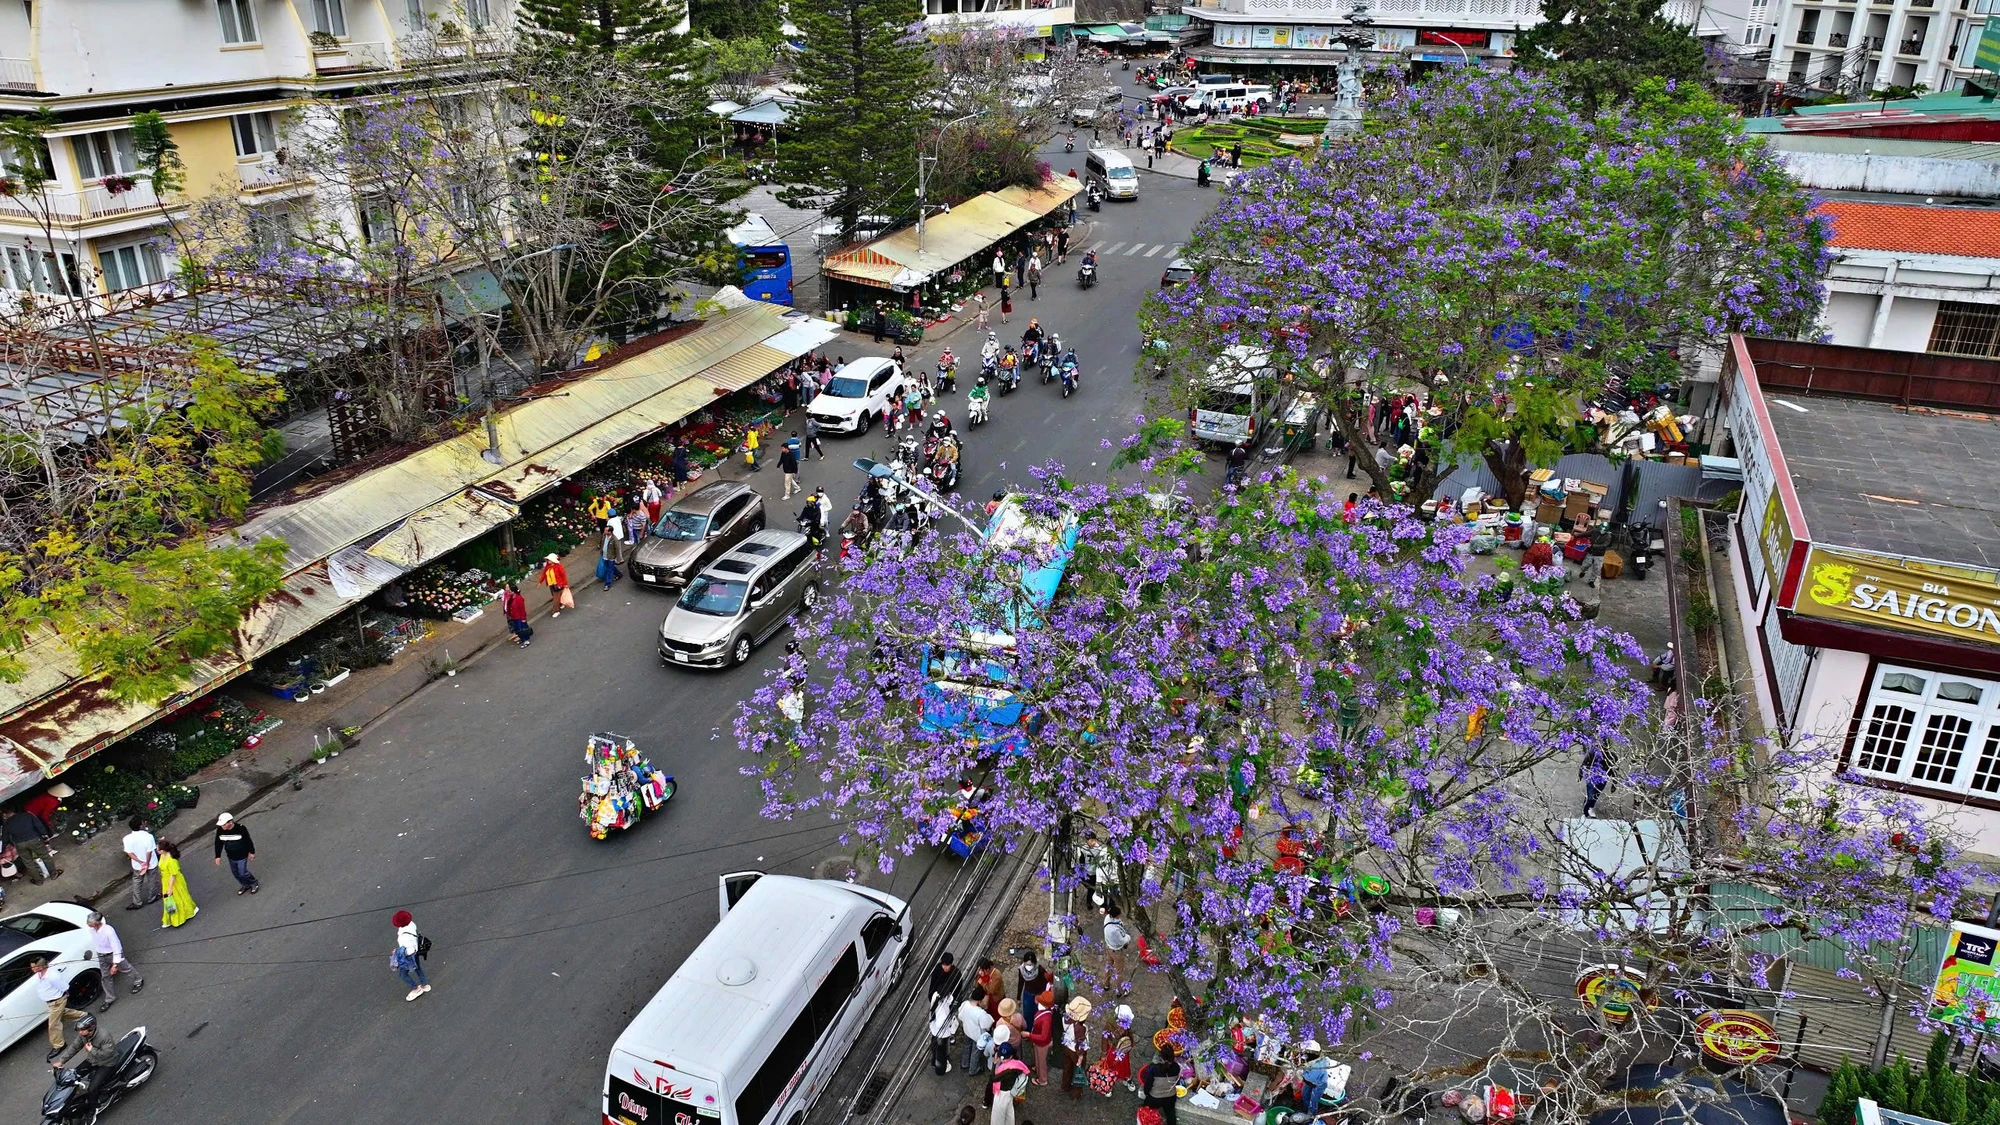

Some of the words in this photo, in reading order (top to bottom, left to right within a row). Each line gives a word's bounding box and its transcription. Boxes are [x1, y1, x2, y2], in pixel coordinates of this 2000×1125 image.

[1922, 582, 1949, 596] BIA
[1850, 583, 2000, 635] SAIGON
[1965, 942, 1985, 954] TTC
